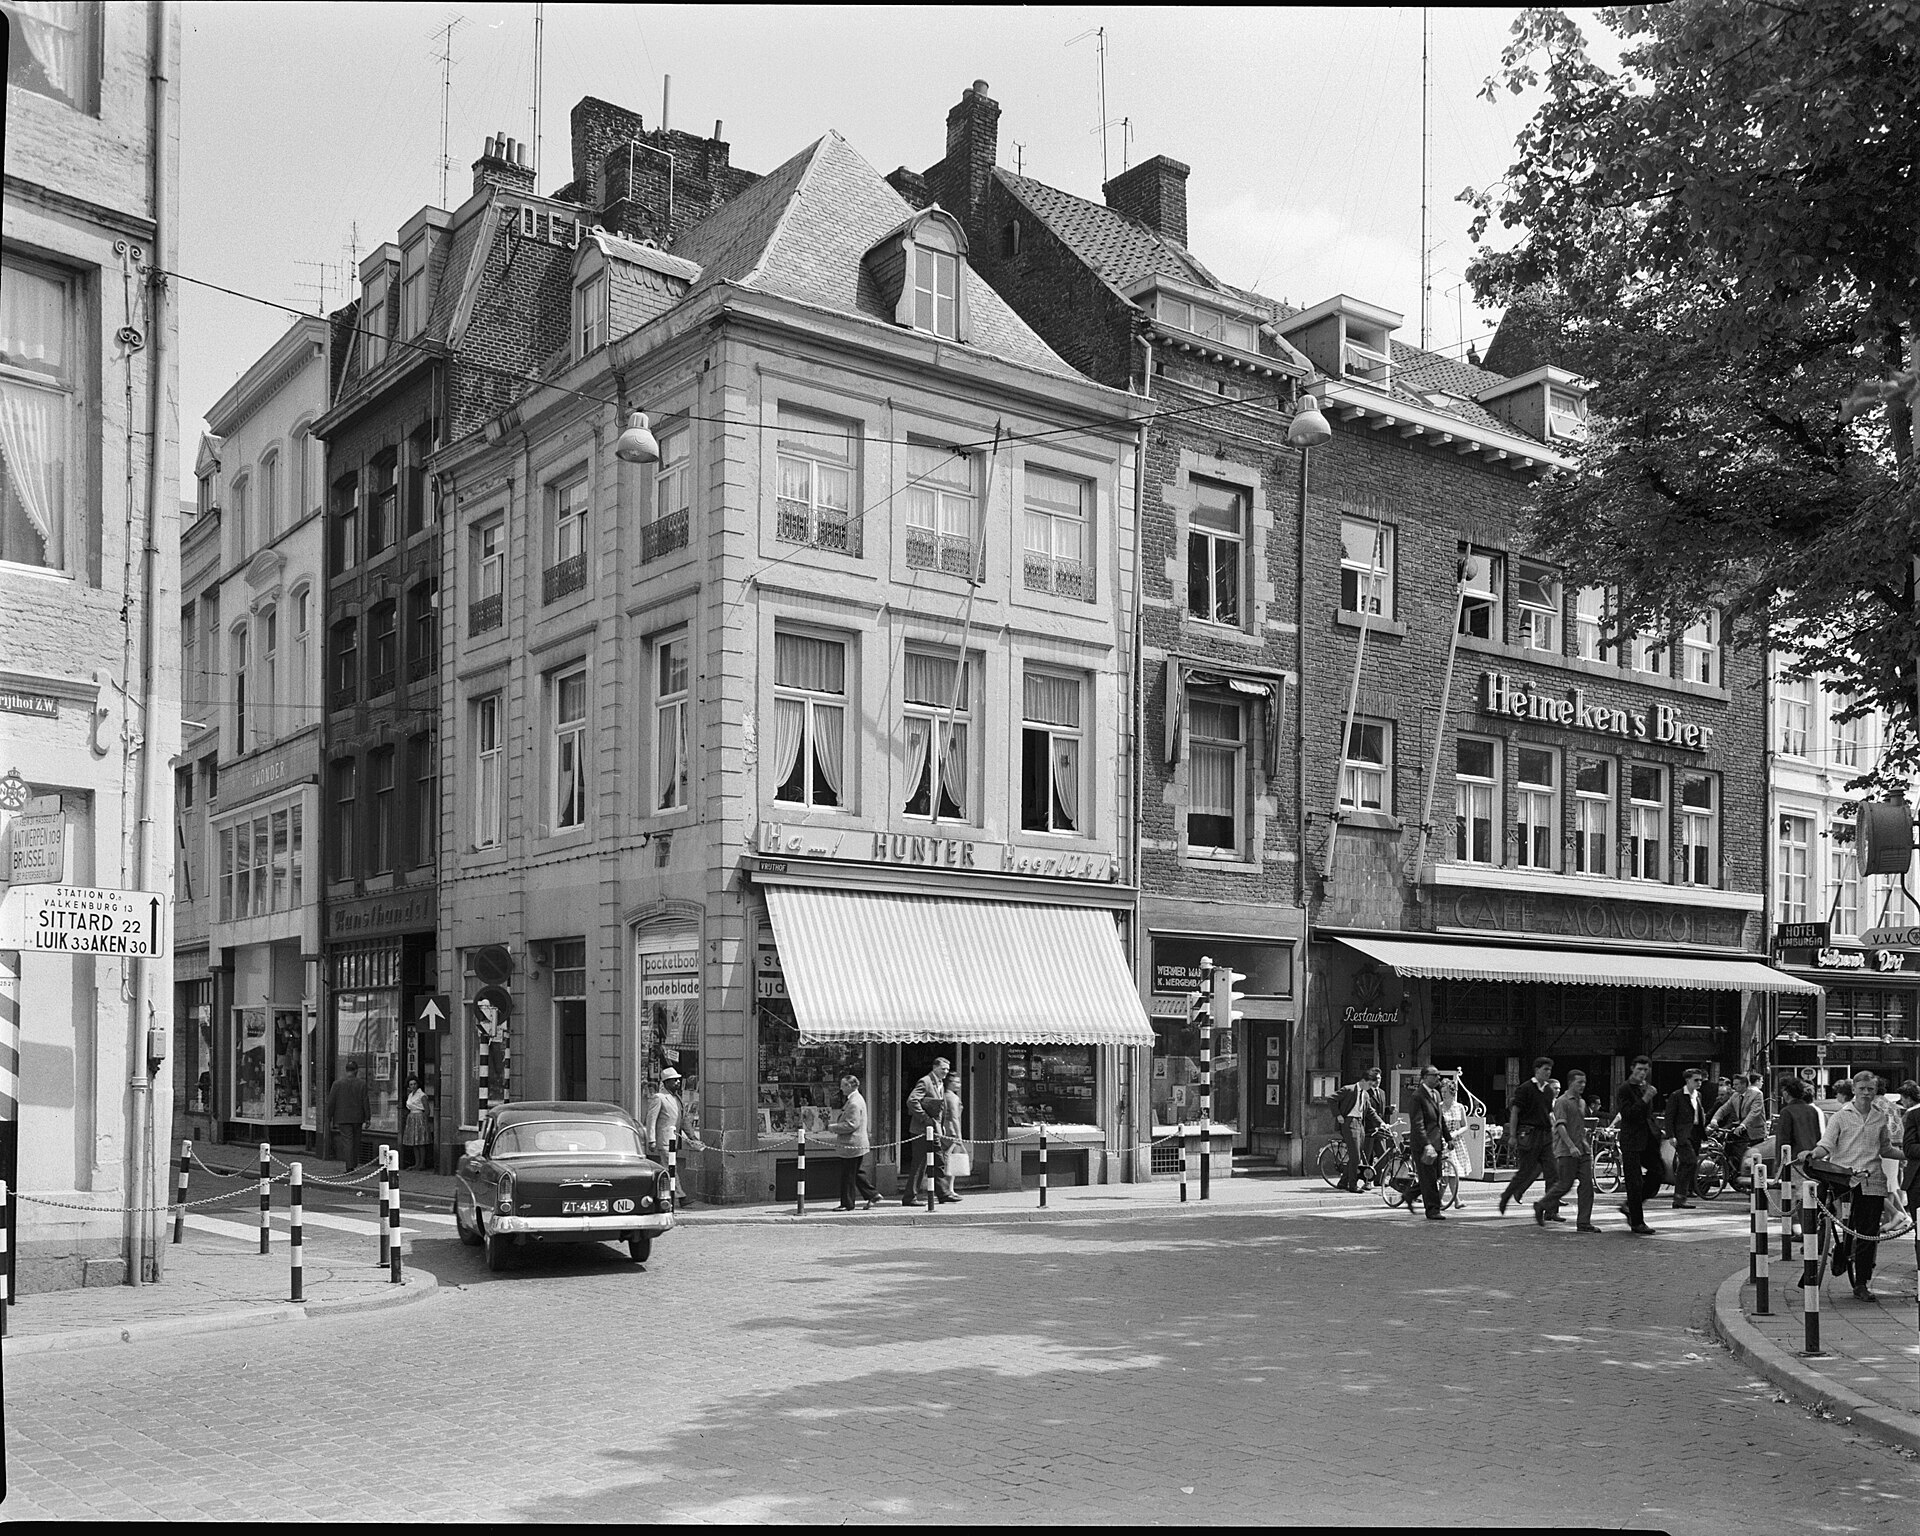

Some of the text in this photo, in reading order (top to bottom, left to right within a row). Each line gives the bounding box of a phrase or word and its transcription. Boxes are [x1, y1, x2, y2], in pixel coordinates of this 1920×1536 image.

[36, 697, 56, 713] Z.W.
[1487, 672, 1713, 748] Heineken's Bier
[48, 829, 61, 845] 109
[873, 832, 975, 866] HUNTER
[14, 848, 46, 870] BRUSSEL
[57, 888, 103, 900] STATION
[44, 899, 133, 912] VALKENBURG 13
[39, 910, 141, 933] SITTARD 22
[36, 931, 147, 954] LUIK 33 AKEN 30
[1778, 925, 1823, 947] HOTEL LIMBURGIA
[1157, 966, 1201, 978] WERNER MA
[1344, 1006, 1399, 1022] Restaurant
[563, 1200, 631, 1213] ZT-41-43 NL
